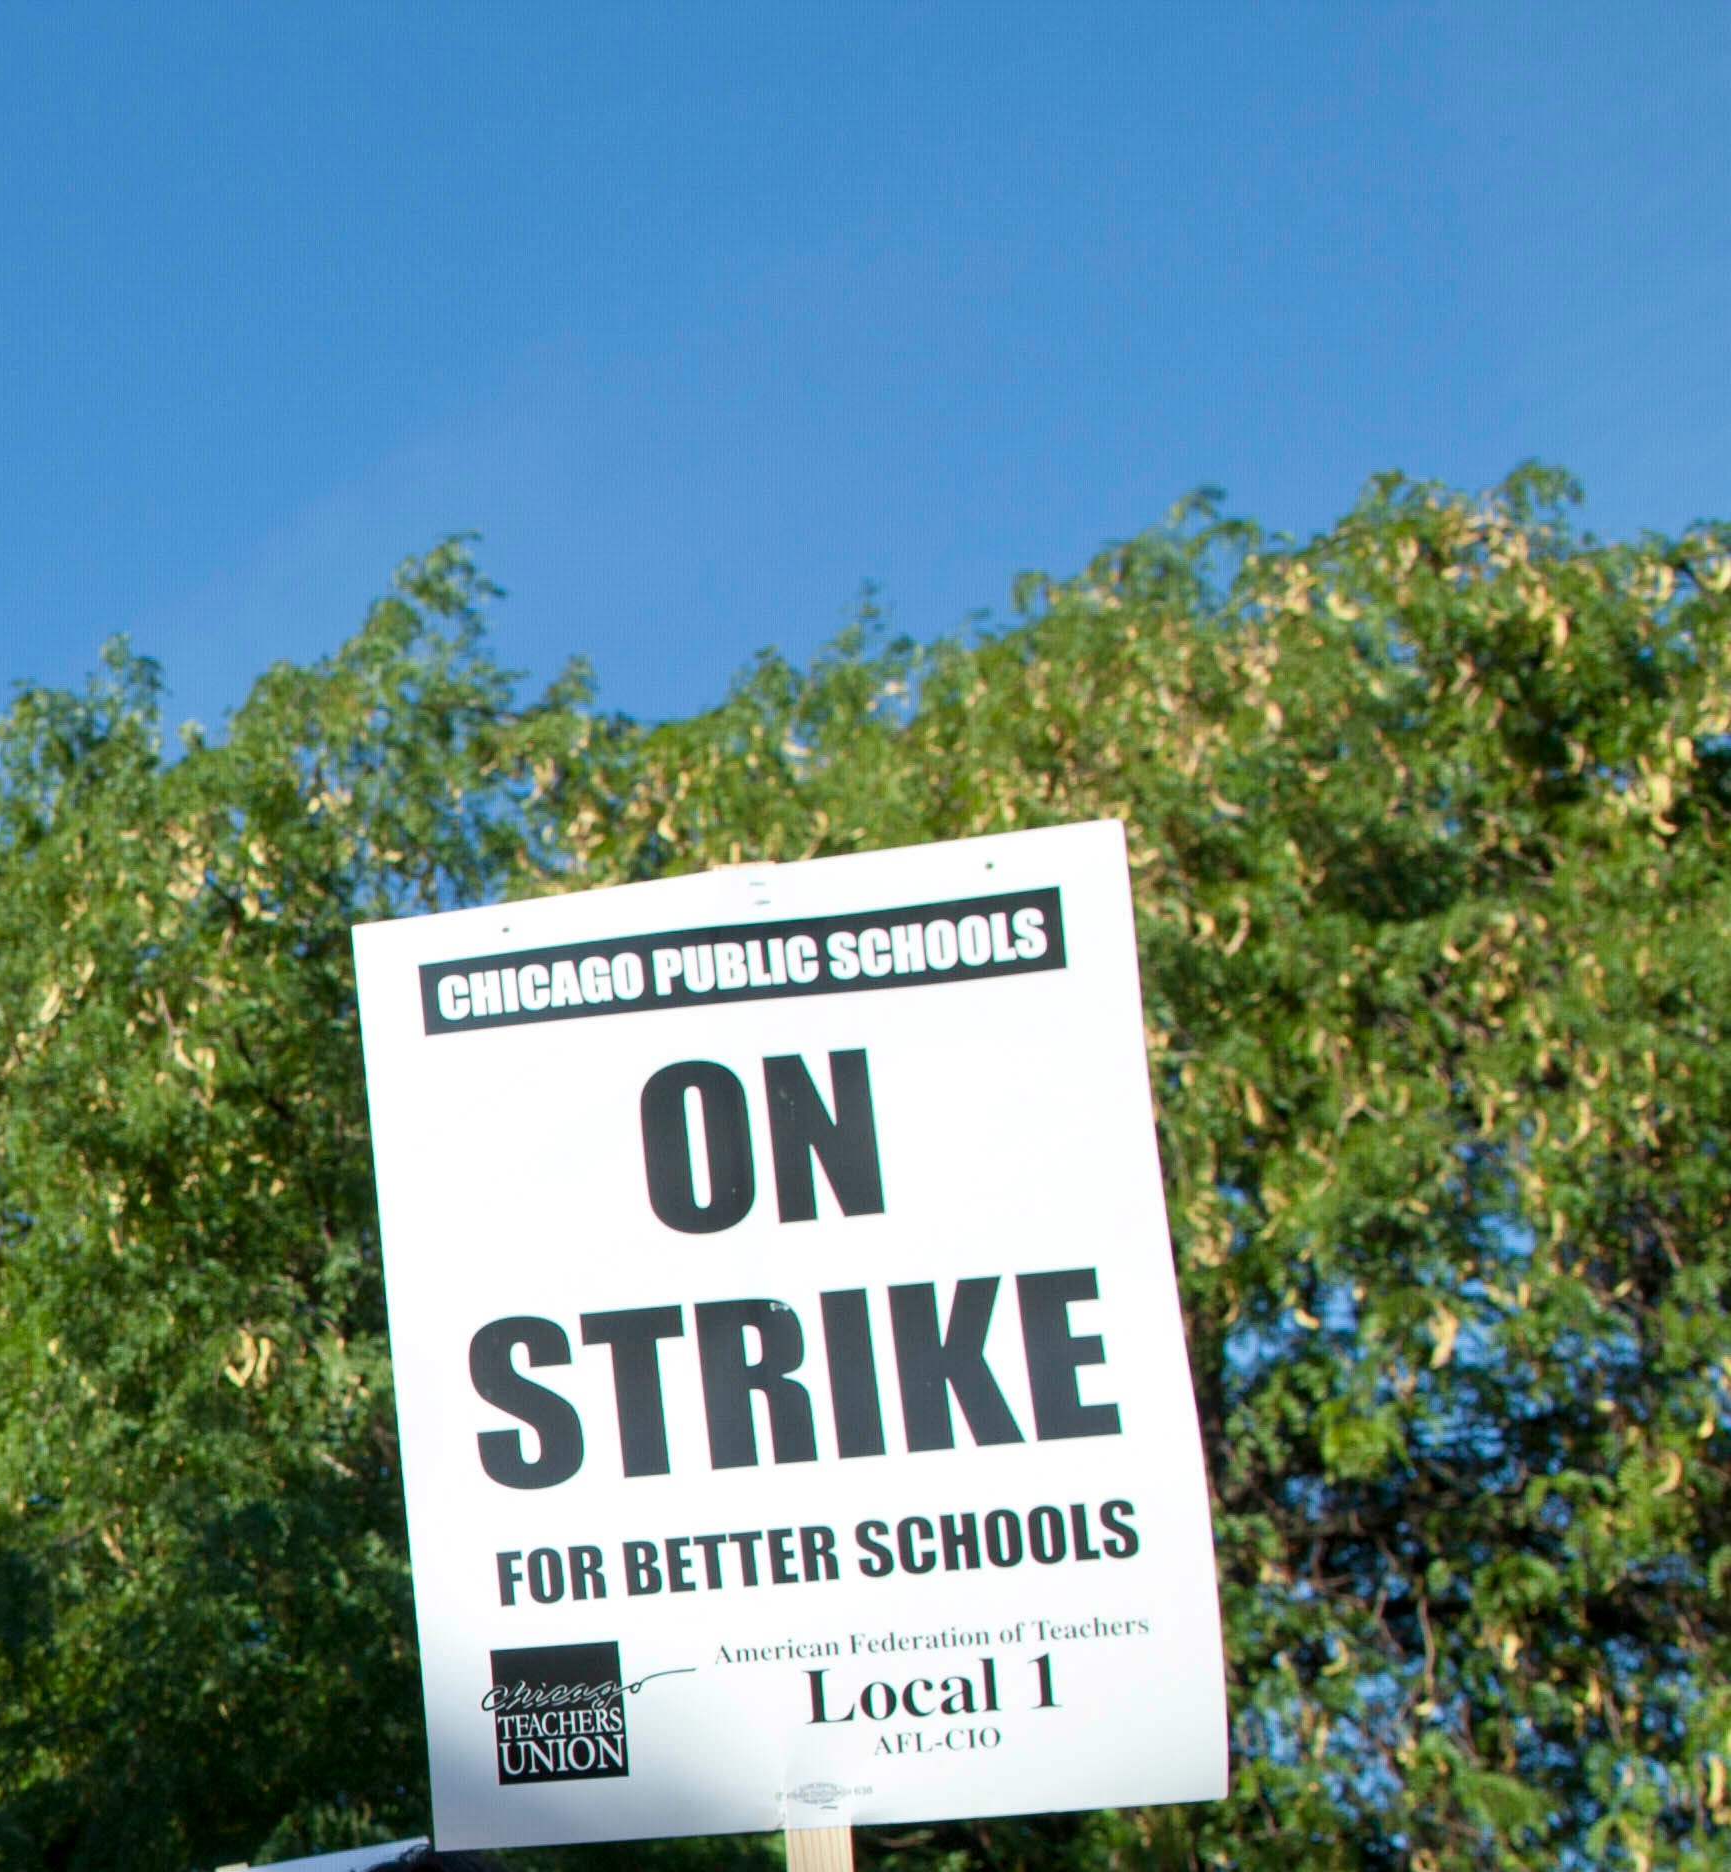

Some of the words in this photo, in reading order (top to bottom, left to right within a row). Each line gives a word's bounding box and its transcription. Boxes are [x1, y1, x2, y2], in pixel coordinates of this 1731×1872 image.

[435, 953, 645, 1021] CHICAGO
[652, 936, 819, 997] PUBLIC
[827, 907, 1049, 981] SCHOOLS
[639, 1047, 886, 1235] ON
[468, 1267, 1123, 1490] STRIKE
[495, 1544, 606, 1607] FOR
[622, 1525, 841, 1597] BETTER
[855, 1498, 1141, 1579] SCHOOLS
[714, 1639, 841, 1666] American
[849, 1627, 991, 1656] Federation
[999, 1622, 1025, 1645] of
[1030, 1616, 1151, 1643] Teachers
[497, 1706, 624, 1741] TEACHERS
[801, 1657, 1003, 1725] Local
[1026, 1652, 1064, 1710] 1
[499, 1733, 625, 1776] UNION
[873, 1727, 1002, 1757] AFL-CIO
